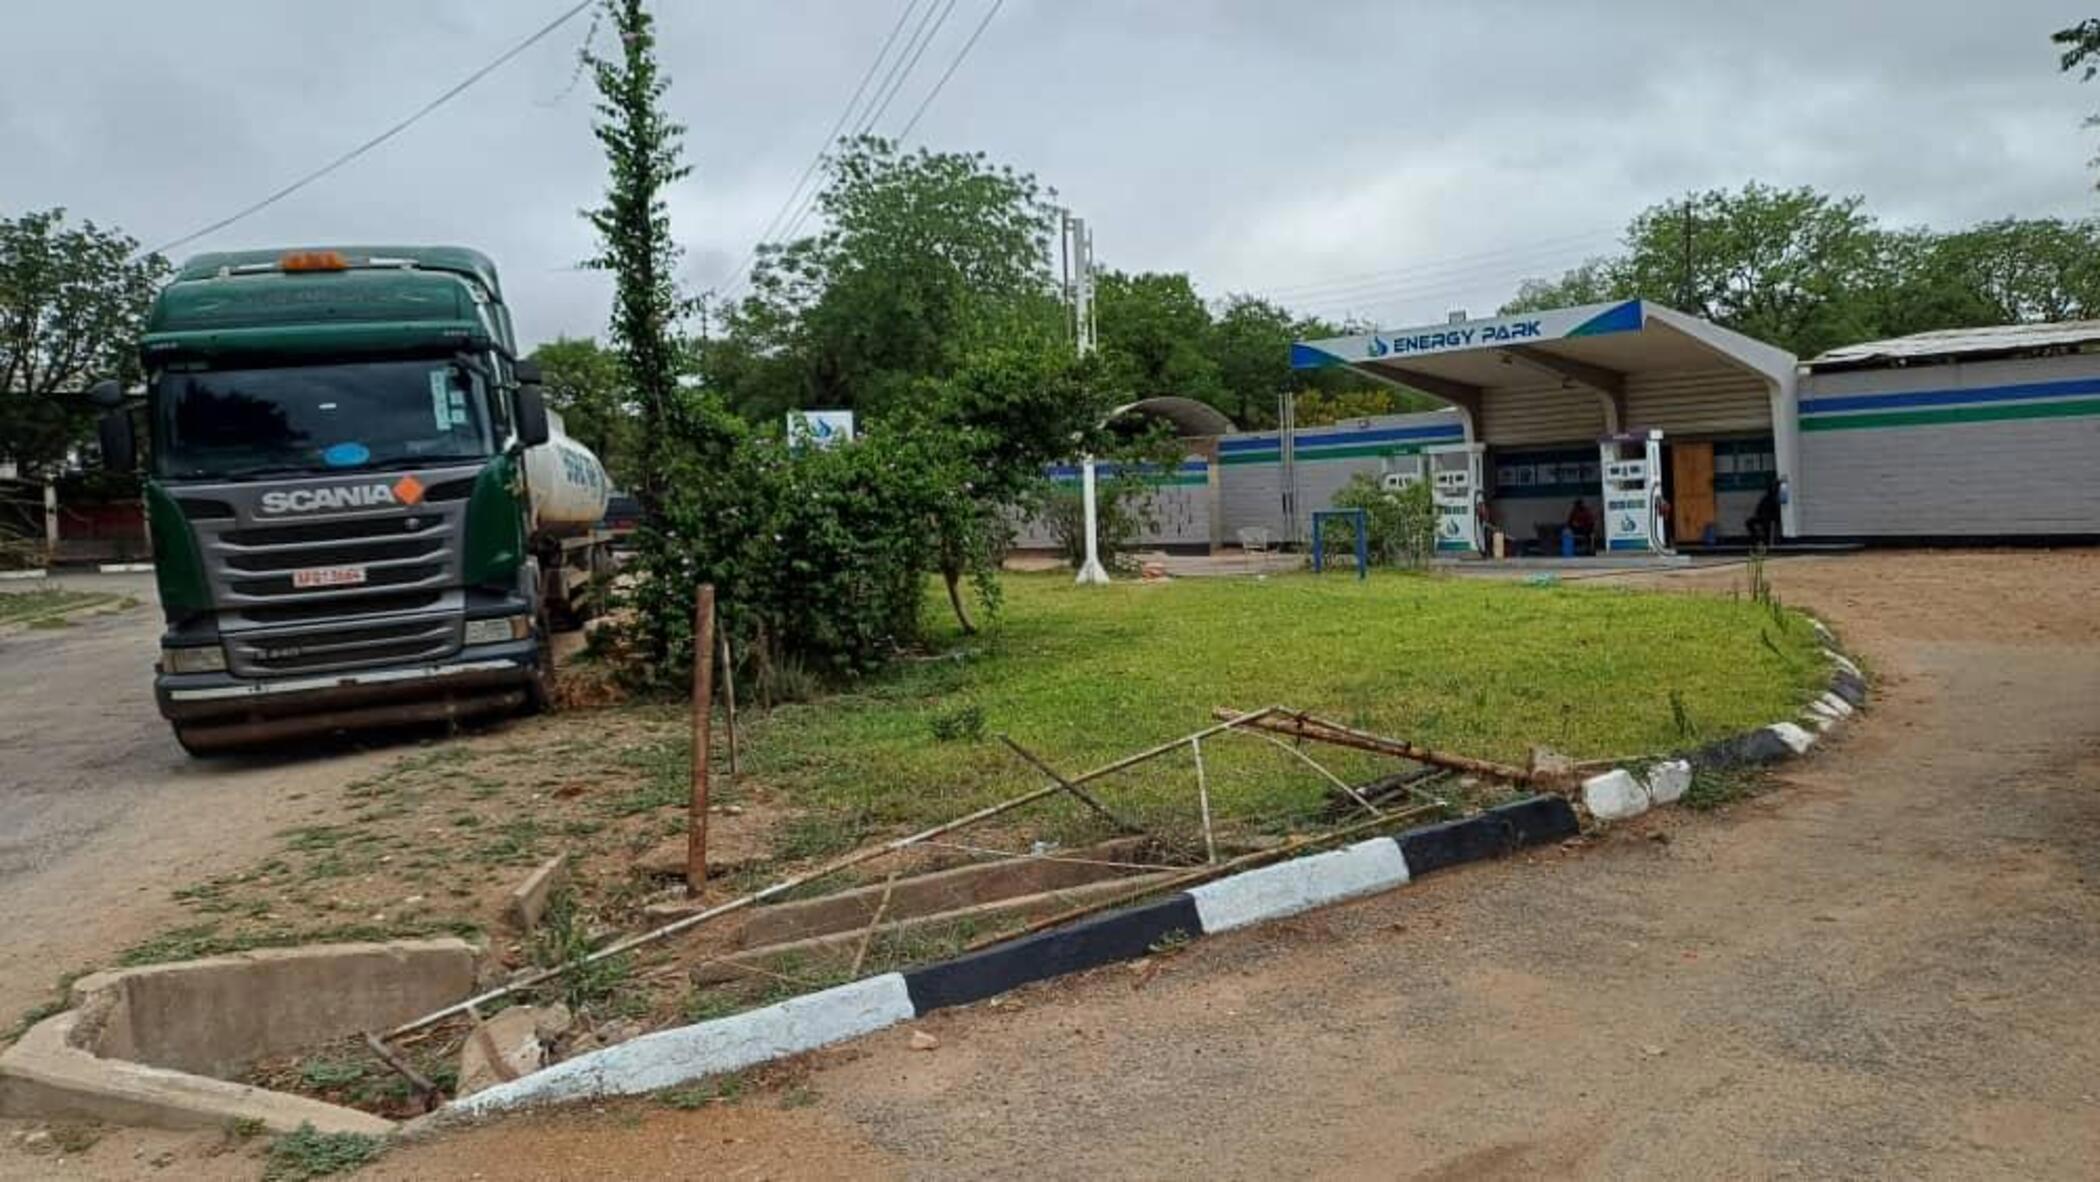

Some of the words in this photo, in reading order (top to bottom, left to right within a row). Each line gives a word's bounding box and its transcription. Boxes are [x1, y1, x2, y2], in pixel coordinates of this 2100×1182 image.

[1394, 329, 1475, 352] ENERGY
[1481, 320, 1541, 343] PARK
[262, 484, 396, 513] SCANIA
